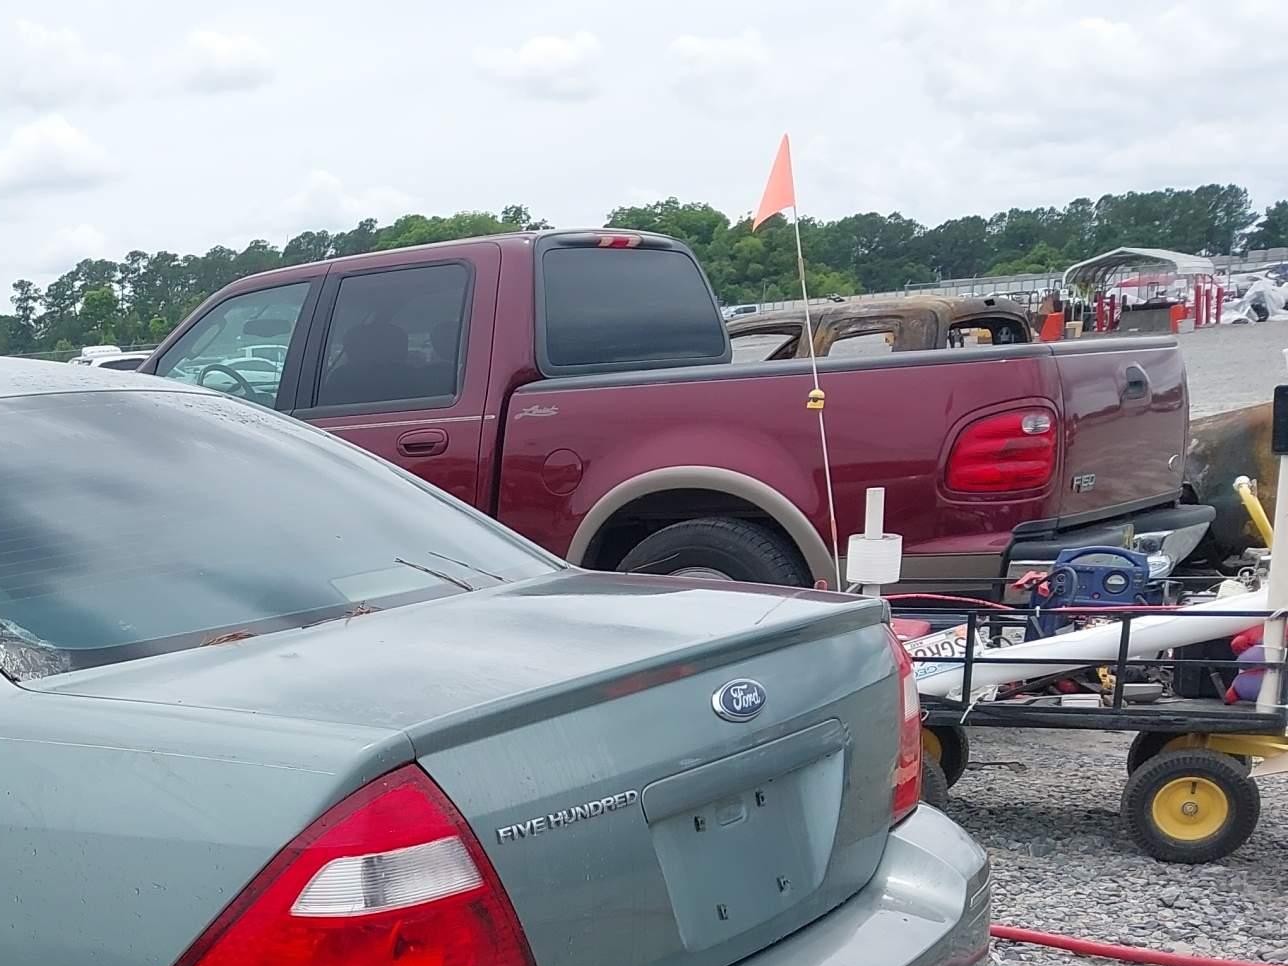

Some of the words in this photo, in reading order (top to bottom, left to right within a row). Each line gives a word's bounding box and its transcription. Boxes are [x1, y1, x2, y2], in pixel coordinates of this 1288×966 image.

[730, 683, 761, 711] Ford
[496, 817, 547, 844] FIVE
[547, 790, 639, 829] HUNDRED
